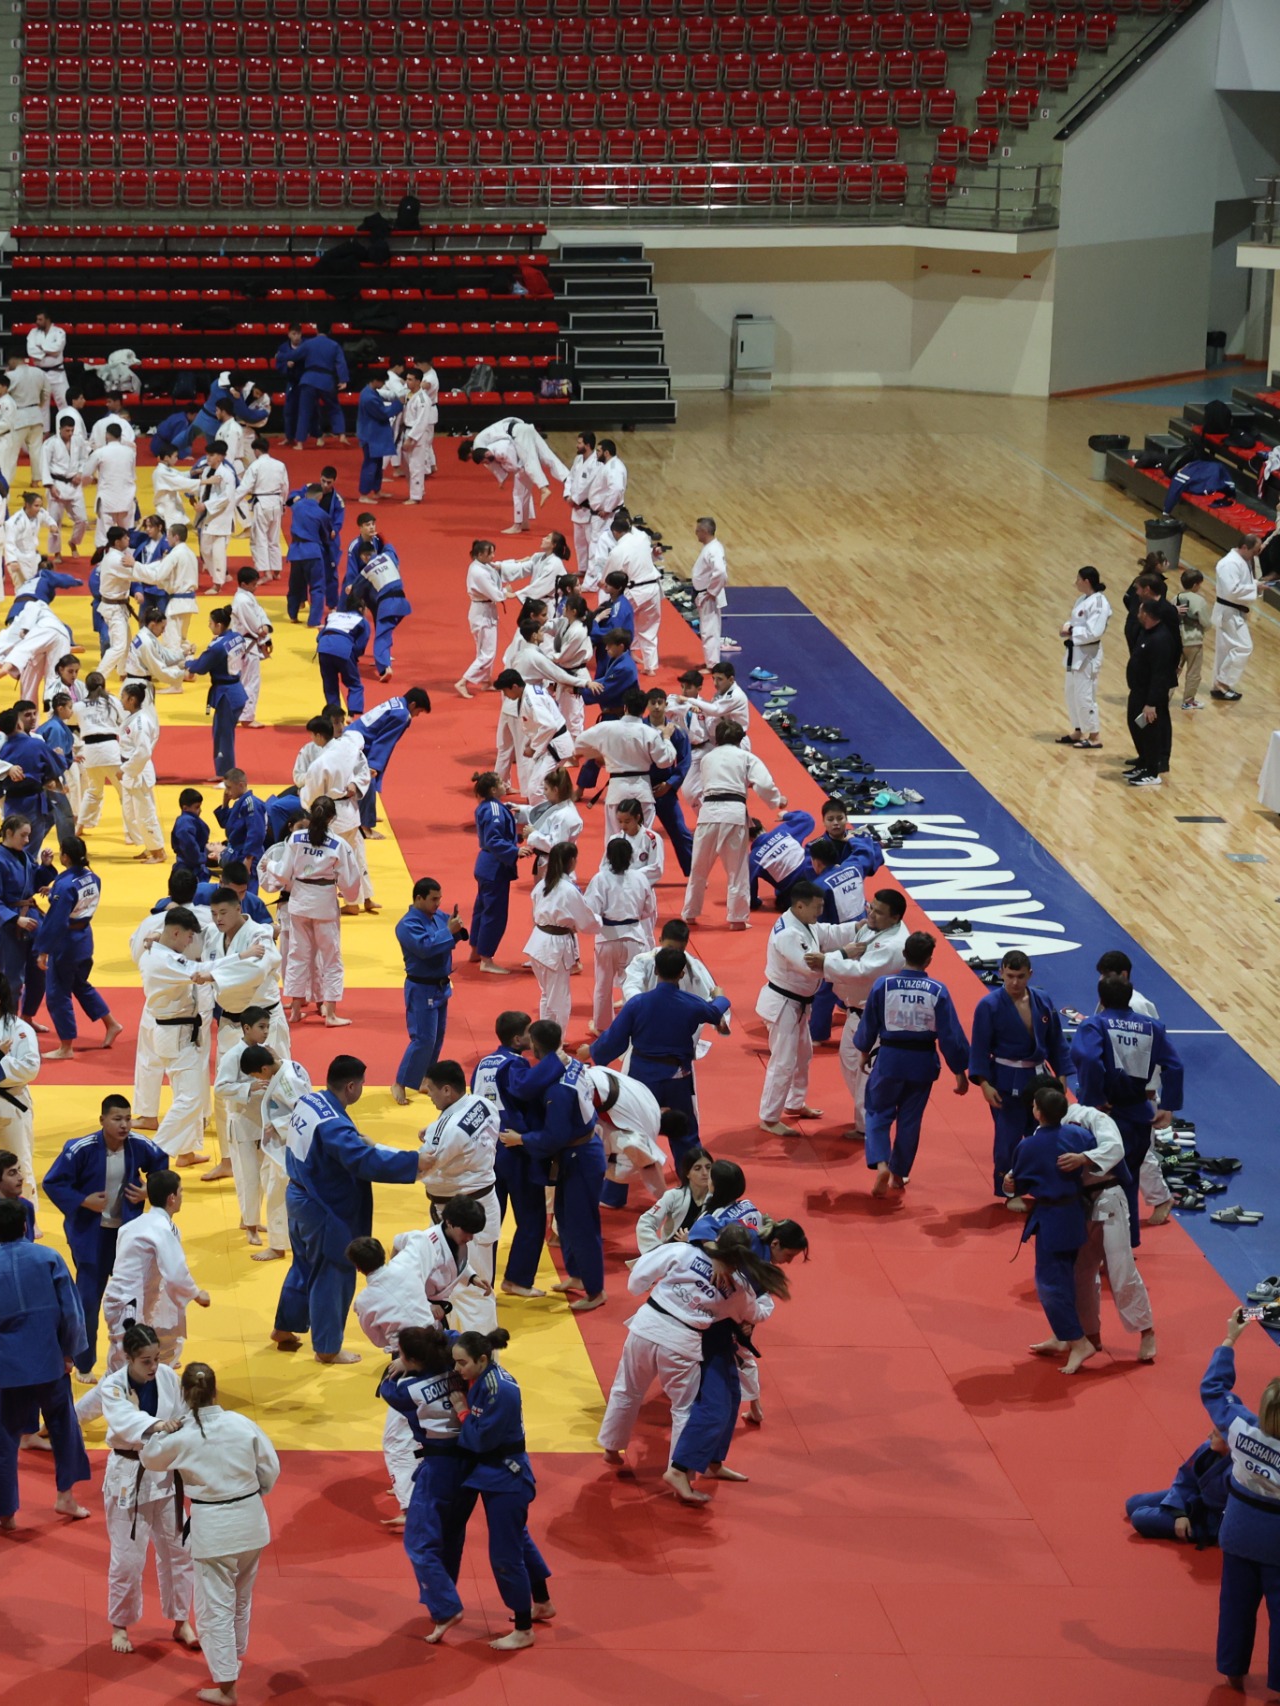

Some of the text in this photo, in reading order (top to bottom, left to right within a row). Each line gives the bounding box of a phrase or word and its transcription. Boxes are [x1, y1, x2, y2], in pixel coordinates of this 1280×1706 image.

[373, 566, 389, 575] TUR
[303, 847, 324, 857] TUR
[770, 843, 788, 858] TUR
[842, 882, 857, 894] KAZ
[847, 814, 1083, 962] KONYA
[896, 979, 931, 991] Y.YAZGAN
[900, 994, 925, 1005] TUR
[1116, 1035, 1138, 1047] TUR
[289, 1112, 308, 1136] KAZ
[695, 1280, 715, 1299] GEO
[1245, 1460, 1271, 1480] GEO
